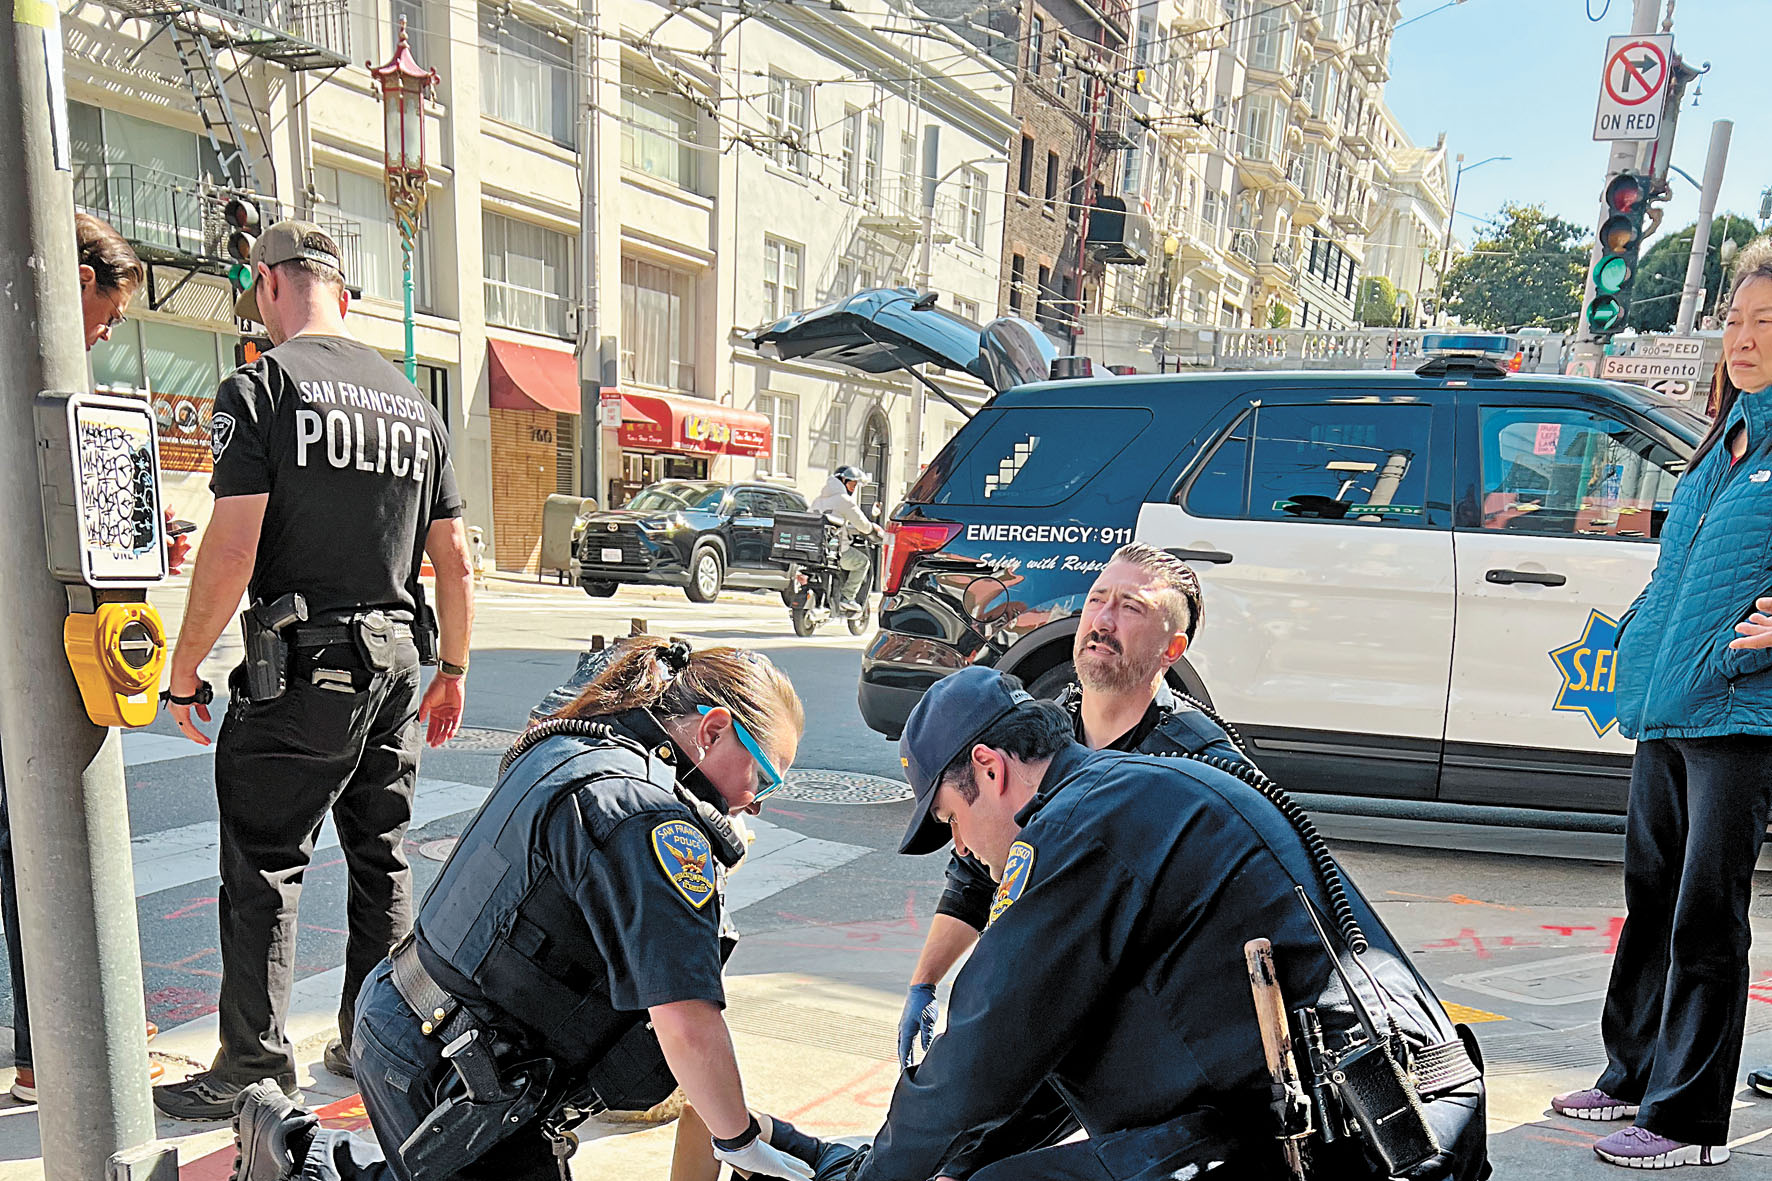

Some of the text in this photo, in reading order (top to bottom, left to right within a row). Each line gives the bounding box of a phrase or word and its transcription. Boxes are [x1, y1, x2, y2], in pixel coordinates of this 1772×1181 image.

[1601, 113, 1656, 130] ON RED
[1642, 347, 1660, 355] 900
[1607, 361, 1696, 376] Sacramento
[300, 380, 426, 422] SAN FRANCISCO
[296, 409, 431, 482] POLICE
[1100, 528, 1133, 544] 911
[976, 552, 1107, 575] Safety with Respec
[657, 825, 675, 839] SAN
[674, 835, 701, 850] POLICE
